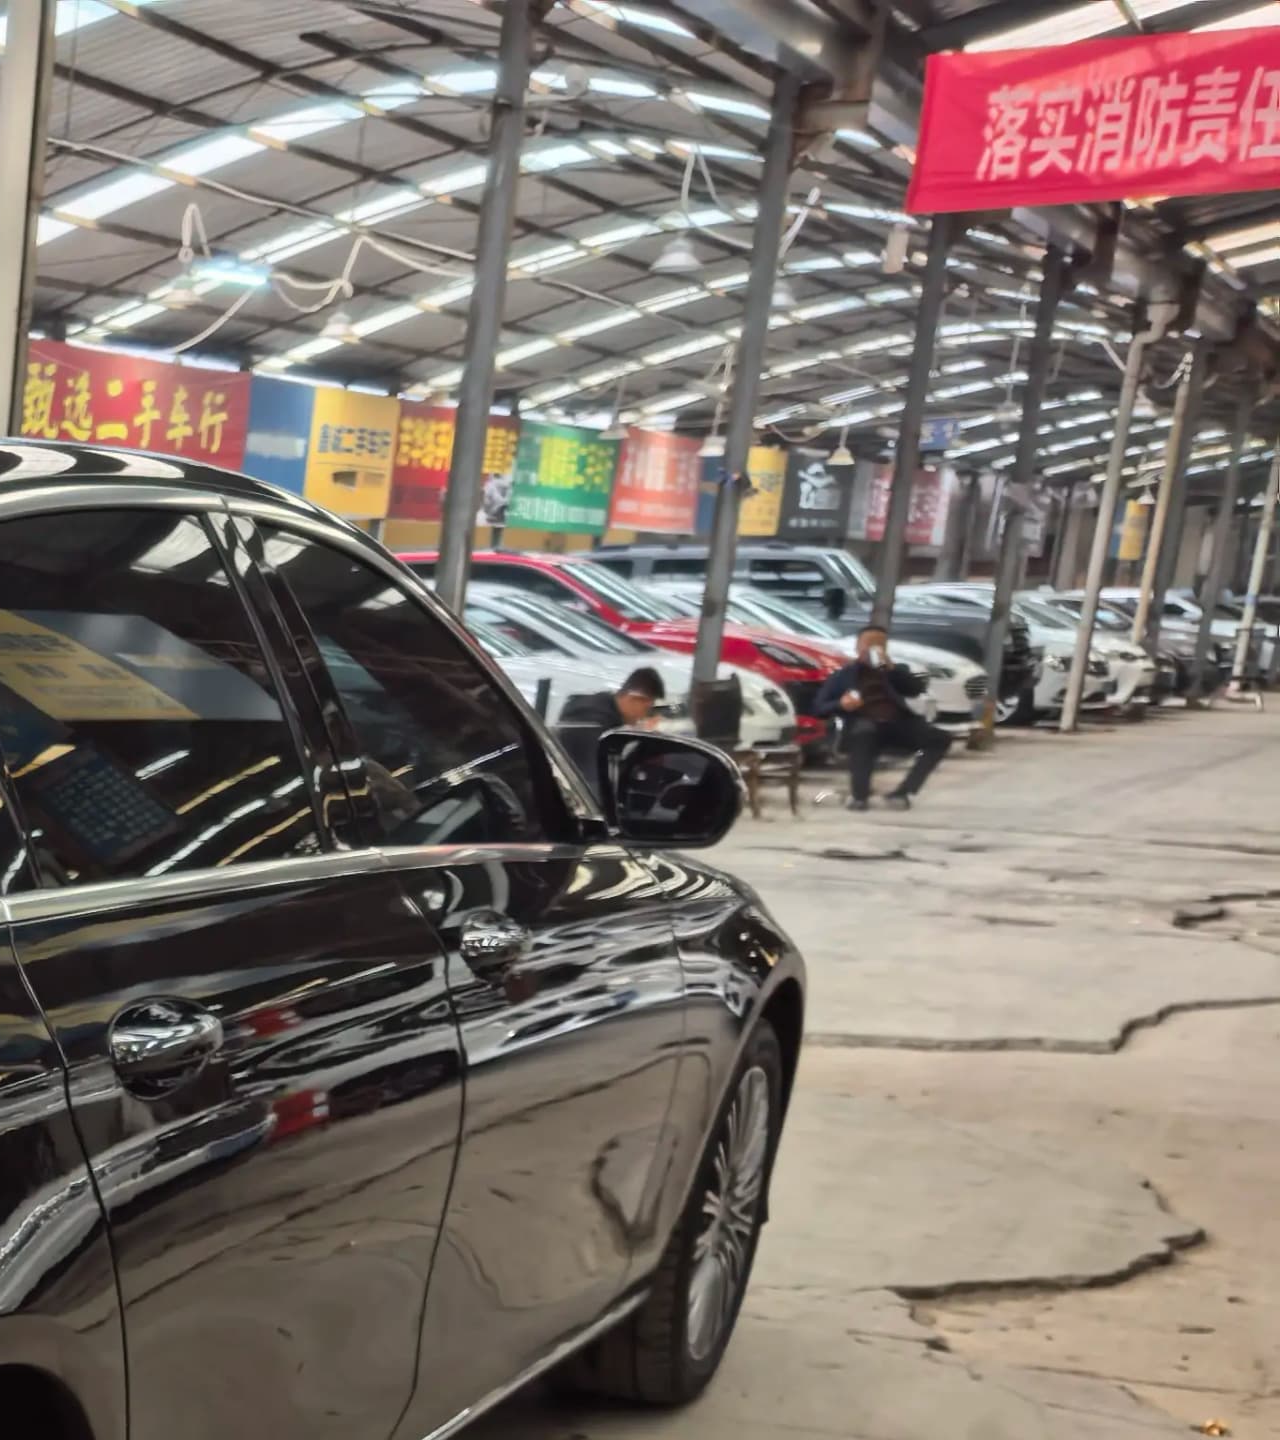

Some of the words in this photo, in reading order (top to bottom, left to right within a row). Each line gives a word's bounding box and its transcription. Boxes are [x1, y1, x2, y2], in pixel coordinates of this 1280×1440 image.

[976, 64, 1280, 181] 落实消防责任
[21, 362, 228, 454] 甄选二手车行
